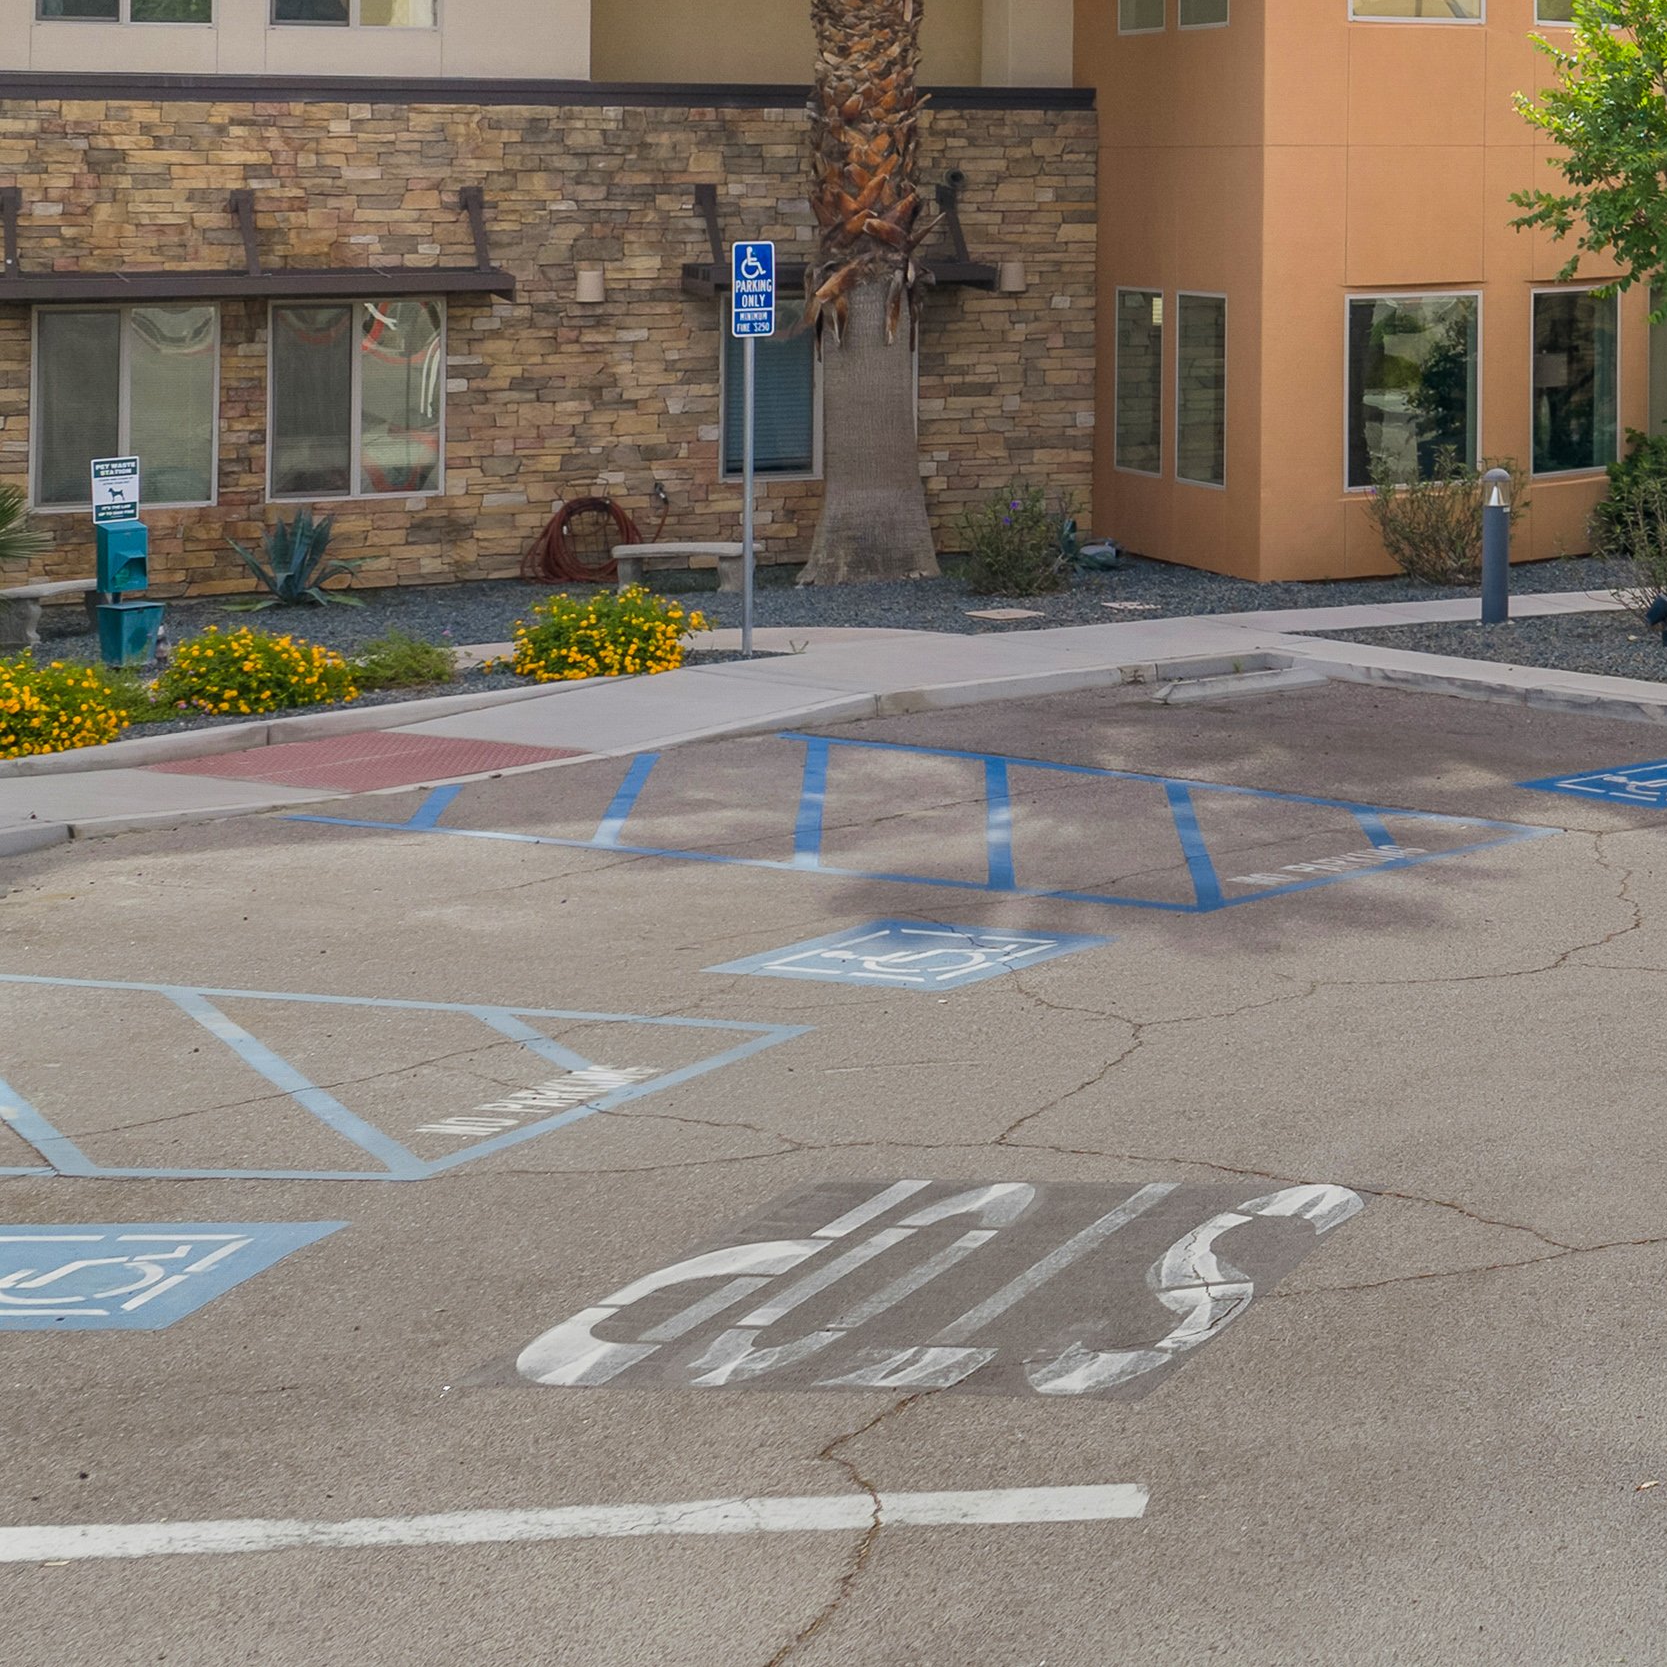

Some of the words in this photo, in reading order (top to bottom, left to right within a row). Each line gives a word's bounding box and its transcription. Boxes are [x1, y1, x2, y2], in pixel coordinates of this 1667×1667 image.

[735, 279, 772, 293] PARKING
[741, 294, 766, 308] ONLY
[739, 312, 768, 321] MINIMUM
[736, 323, 751, 332] FINE
[753, 322, 770, 332] $250
[415, 1116, 520, 1135] NO
[473, 1064, 662, 1114] PARKING
[516, 1180, 1365, 1395] STOP
